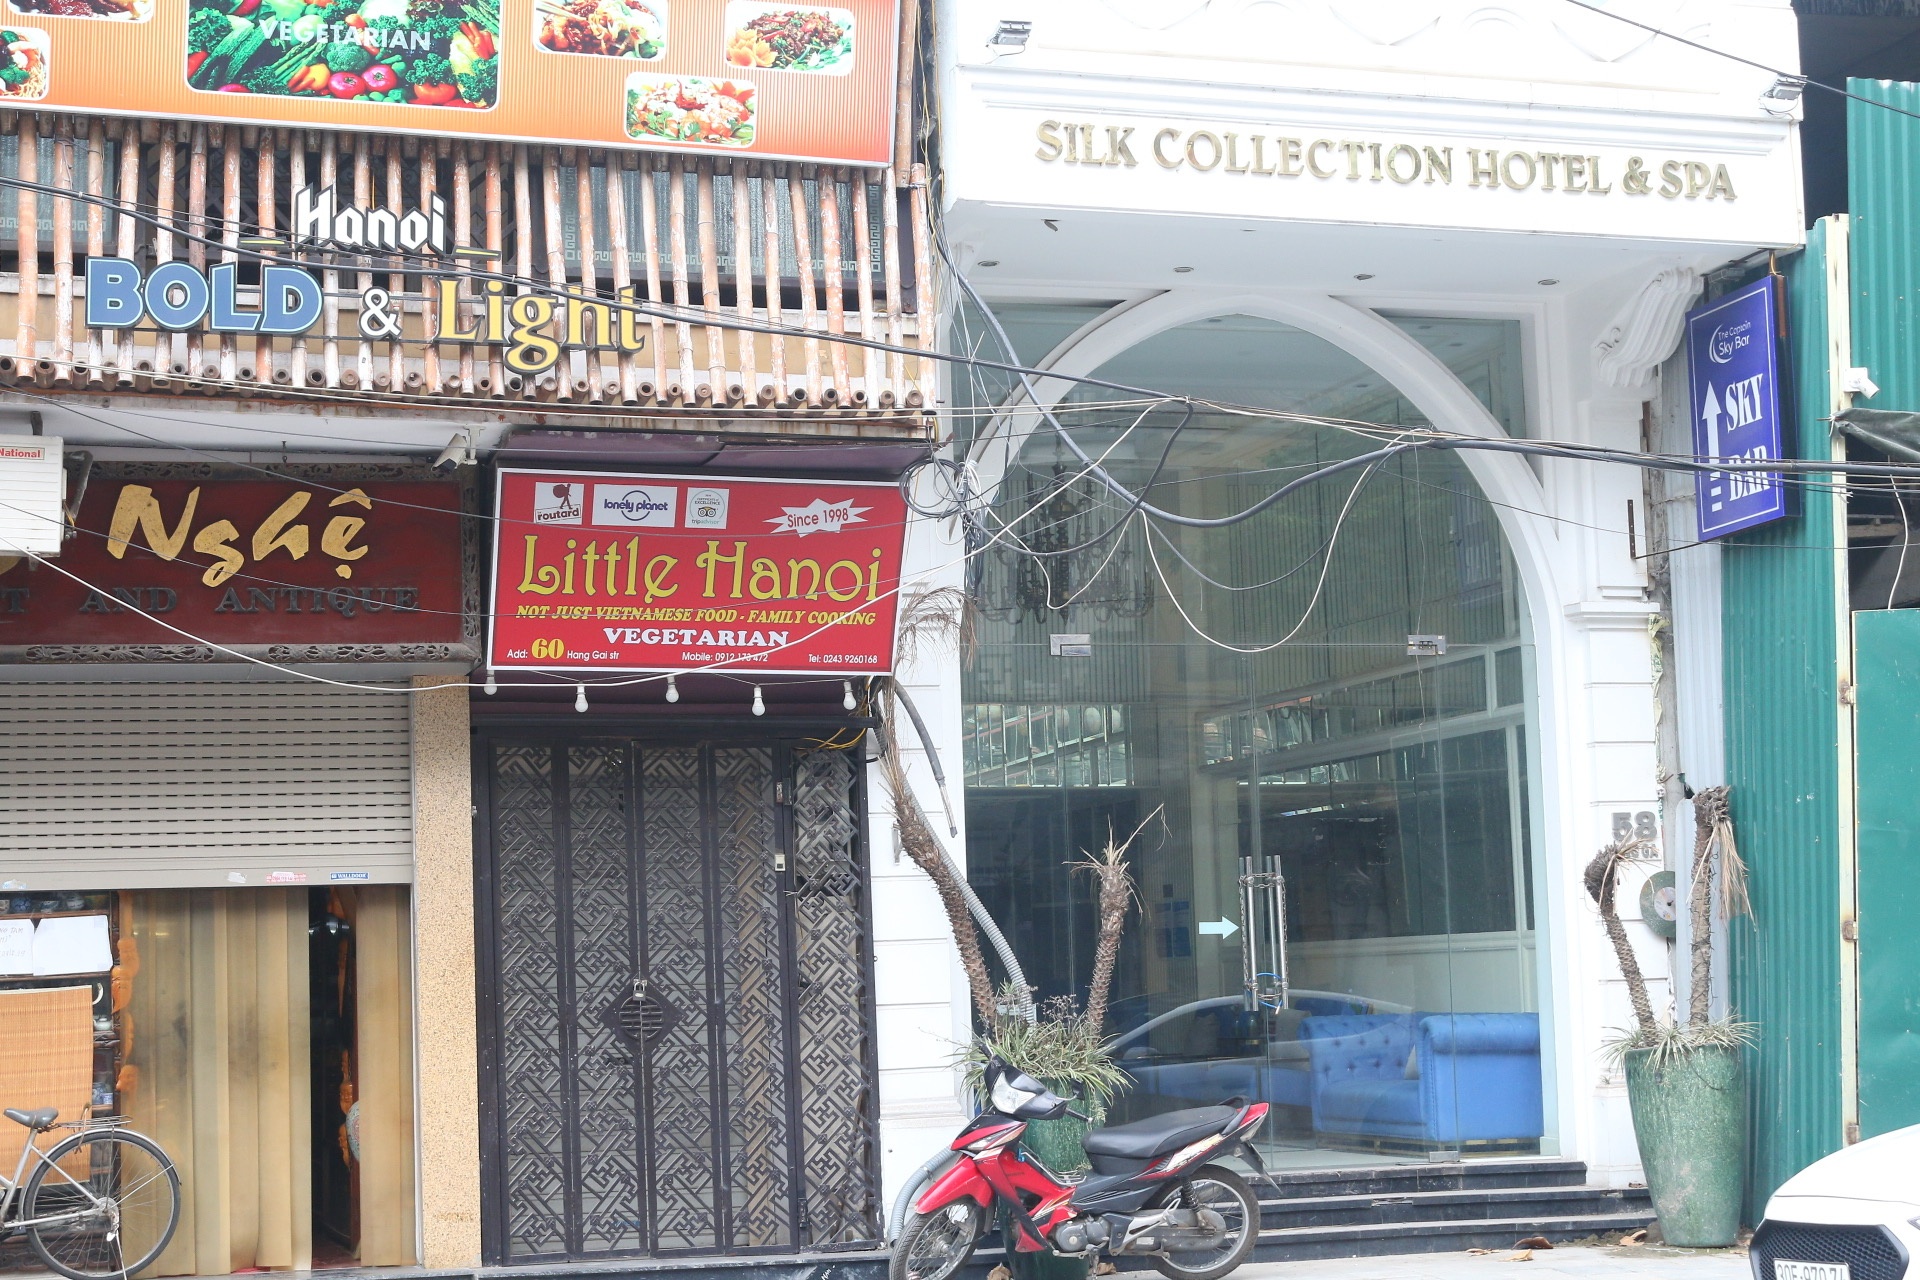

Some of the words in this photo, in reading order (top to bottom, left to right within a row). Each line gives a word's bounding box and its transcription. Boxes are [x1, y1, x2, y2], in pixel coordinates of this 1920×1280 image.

[259, 19, 431, 50] VEGETARIAN
[1035, 119, 1139, 167] SILK
[1152, 127, 1453, 185] COLLECTION
[1467, 147, 1612, 195] HOTEL
[1621, 155, 1653, 195] &
[1657, 159, 1738, 201] SPA
[296, 183, 447, 255] Hanoi
[86, 257, 324, 334] BOLD
[359, 286, 402, 340] &
[437, 277, 646, 375] Light
[1718, 341, 1734, 356] Sky
[1734, 334, 1750, 350] Bar
[1725, 374, 1764, 434] SKY
[1728, 445, 1771, 501] BAR
[537, 508, 580, 521] routard
[604, 499, 635, 513] lonely
[636, 500, 669, 513] planet
[787, 513, 819, 528] Since
[823, 507, 848, 523] 1998
[107, 483, 373, 587] Nghệ
[517, 535, 679, 603] Little
[696, 540, 881, 602] Hanoi
[80, 587, 177, 613] AND
[214, 587, 419, 618] ANTIQUE
[516, 605, 550, 619] NOT
[552, 605, 592, 620] JUST
[595, 606, 693, 622] VIETNAMESE
[695, 608, 737, 623] FOOD
[747, 609, 806, 624] FAMILY
[807, 611, 876, 625] COOKING
[507, 649, 528, 659] Add:
[531, 638, 565, 660] 60
[567, 650, 590, 662] Hang
[592, 651, 608, 660] Gai
[603, 627, 789, 647] VEGETARIAN
[682, 651, 713, 661] Mobile:
[715, 652, 734, 662] 0912
[808, 654, 822, 663] Tel:
[823, 654, 843, 663] 0243
[844, 655, 878, 664] 9260168
[1611, 811, 1658, 841] 58
